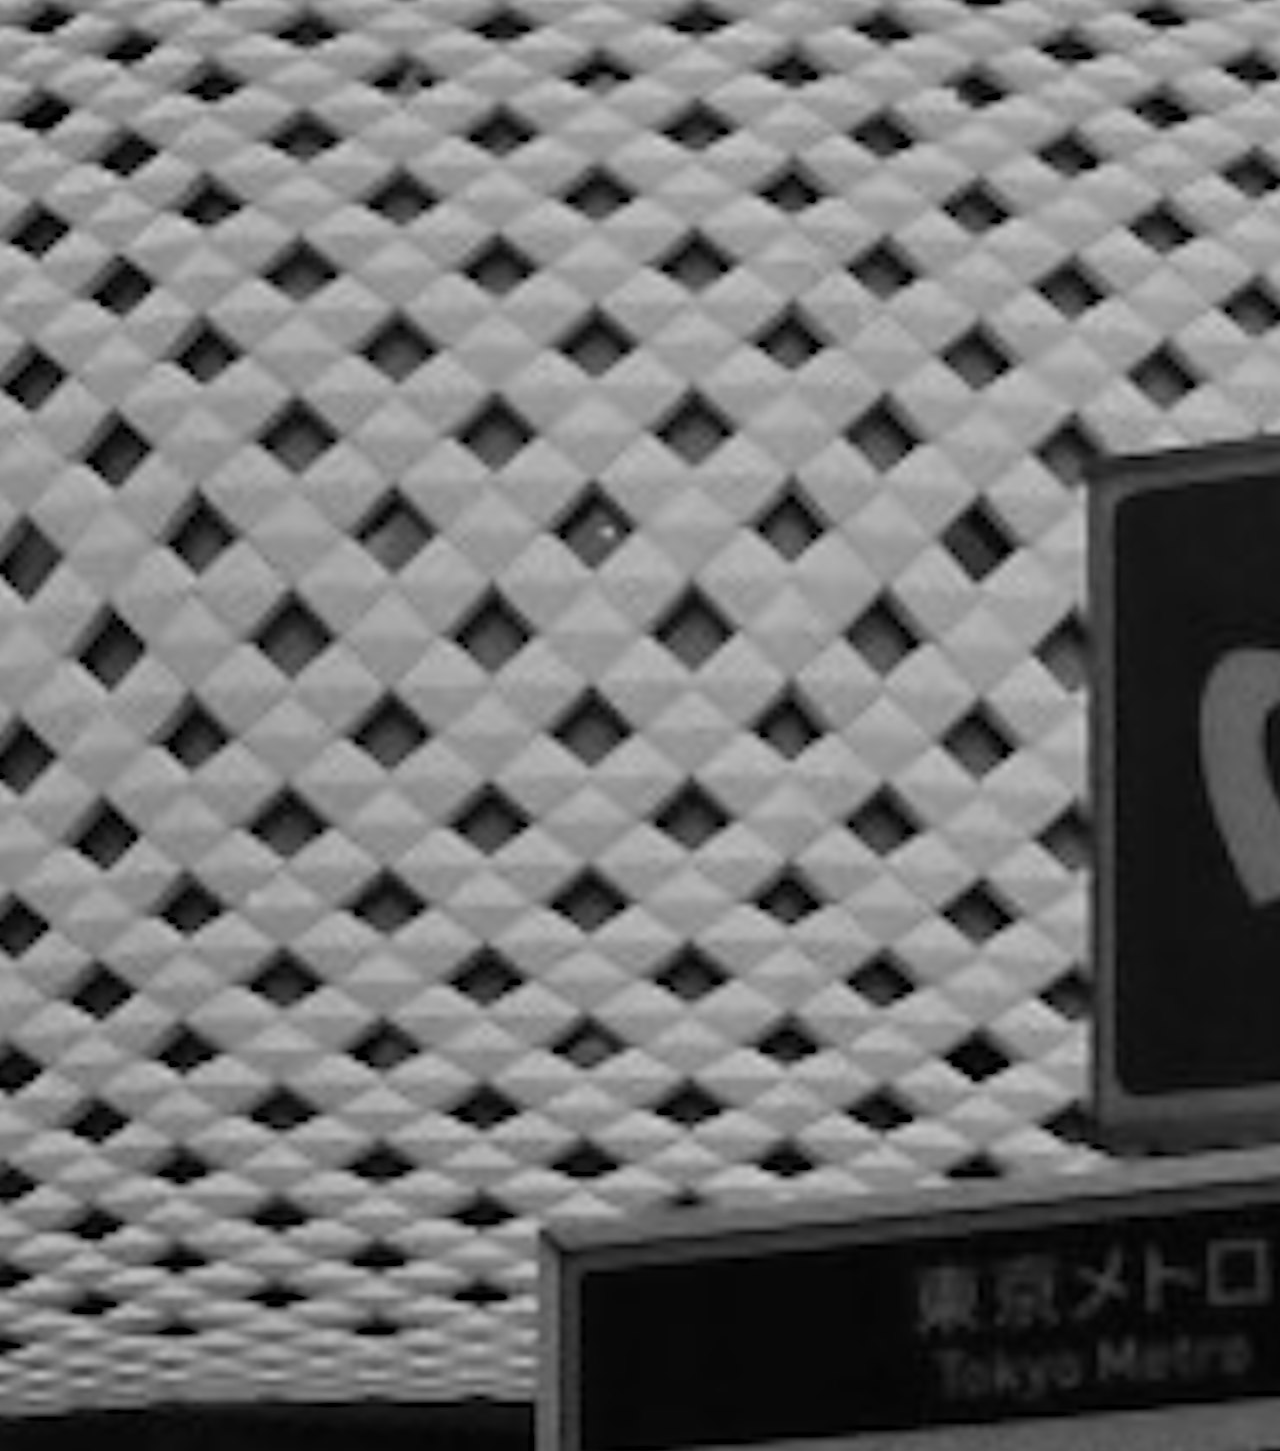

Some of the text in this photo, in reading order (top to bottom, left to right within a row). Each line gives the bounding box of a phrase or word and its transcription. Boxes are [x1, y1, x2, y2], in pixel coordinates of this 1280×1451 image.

[914, 1238, 1274, 1335] 東京メトロ
[932, 1329, 1253, 1404] Tokyo Metro
